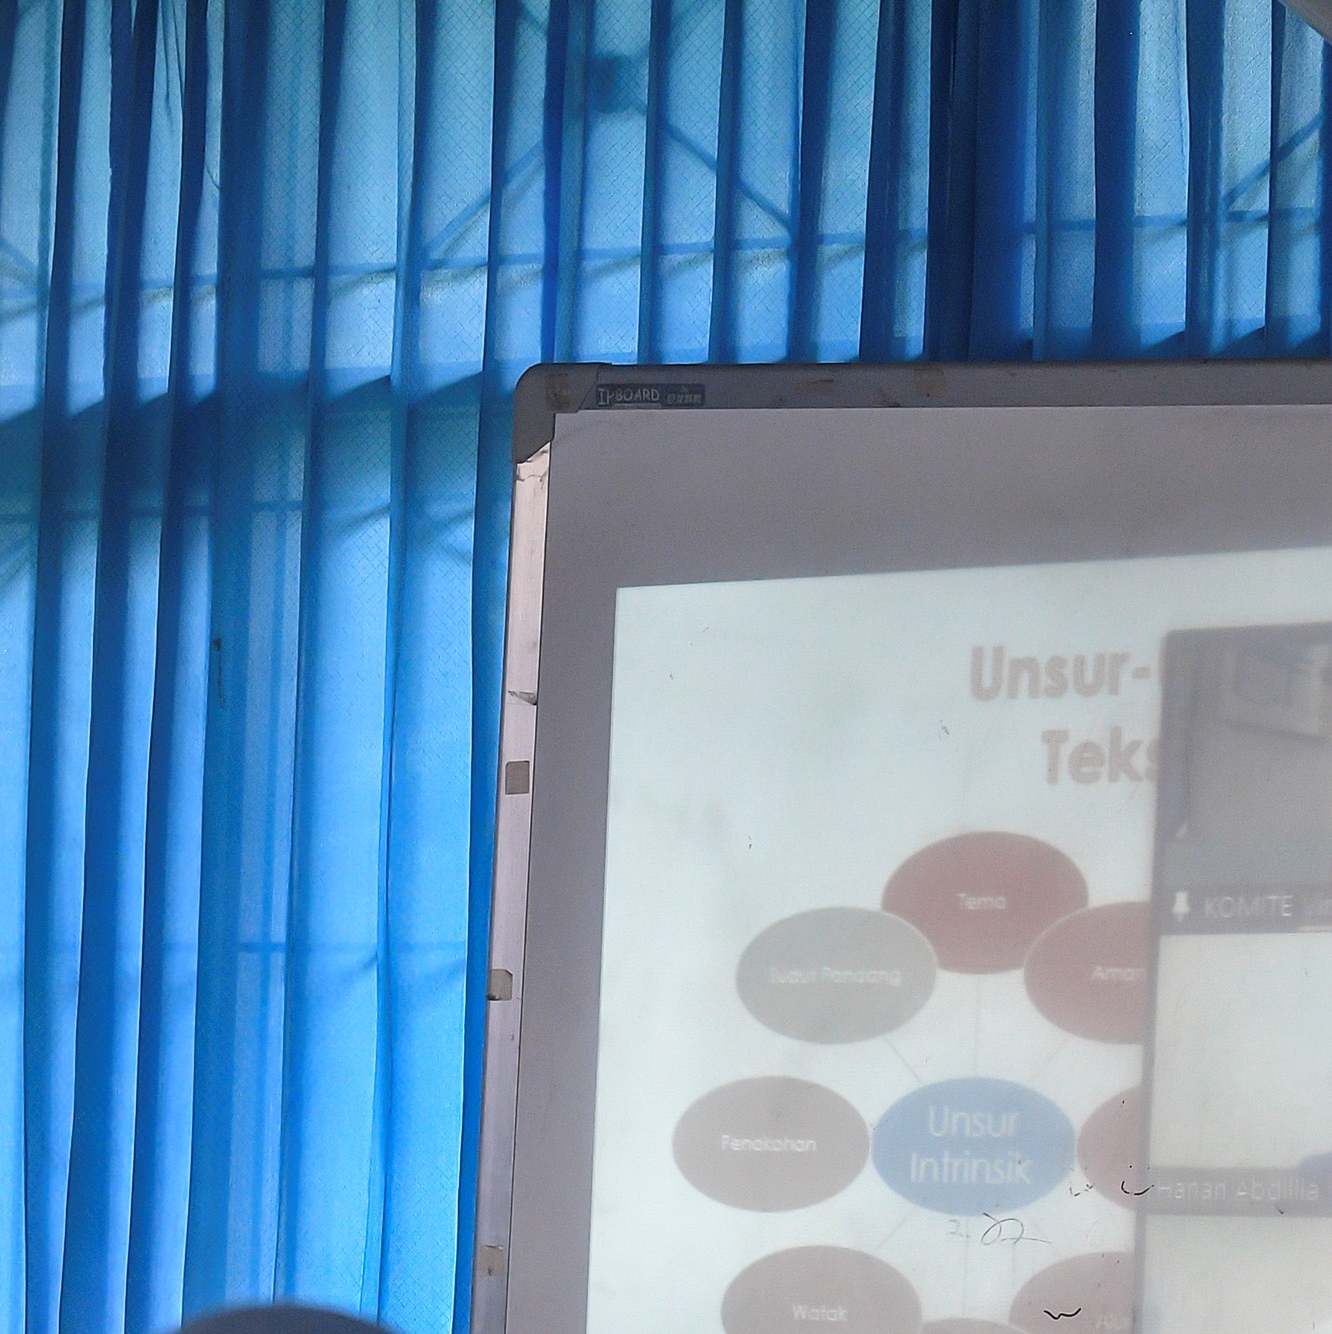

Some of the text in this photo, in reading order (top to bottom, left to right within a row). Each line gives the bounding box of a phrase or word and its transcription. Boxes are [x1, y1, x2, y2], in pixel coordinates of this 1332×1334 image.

[1203, 894, 1293, 918] KOMITE
[928, 1104, 1021, 1138] Unsur
[720, 1134, 817, 1154] Penokohan
[909, 1150, 1033, 1186] Intrinsik
[792, 1303, 849, 1322] Watak
